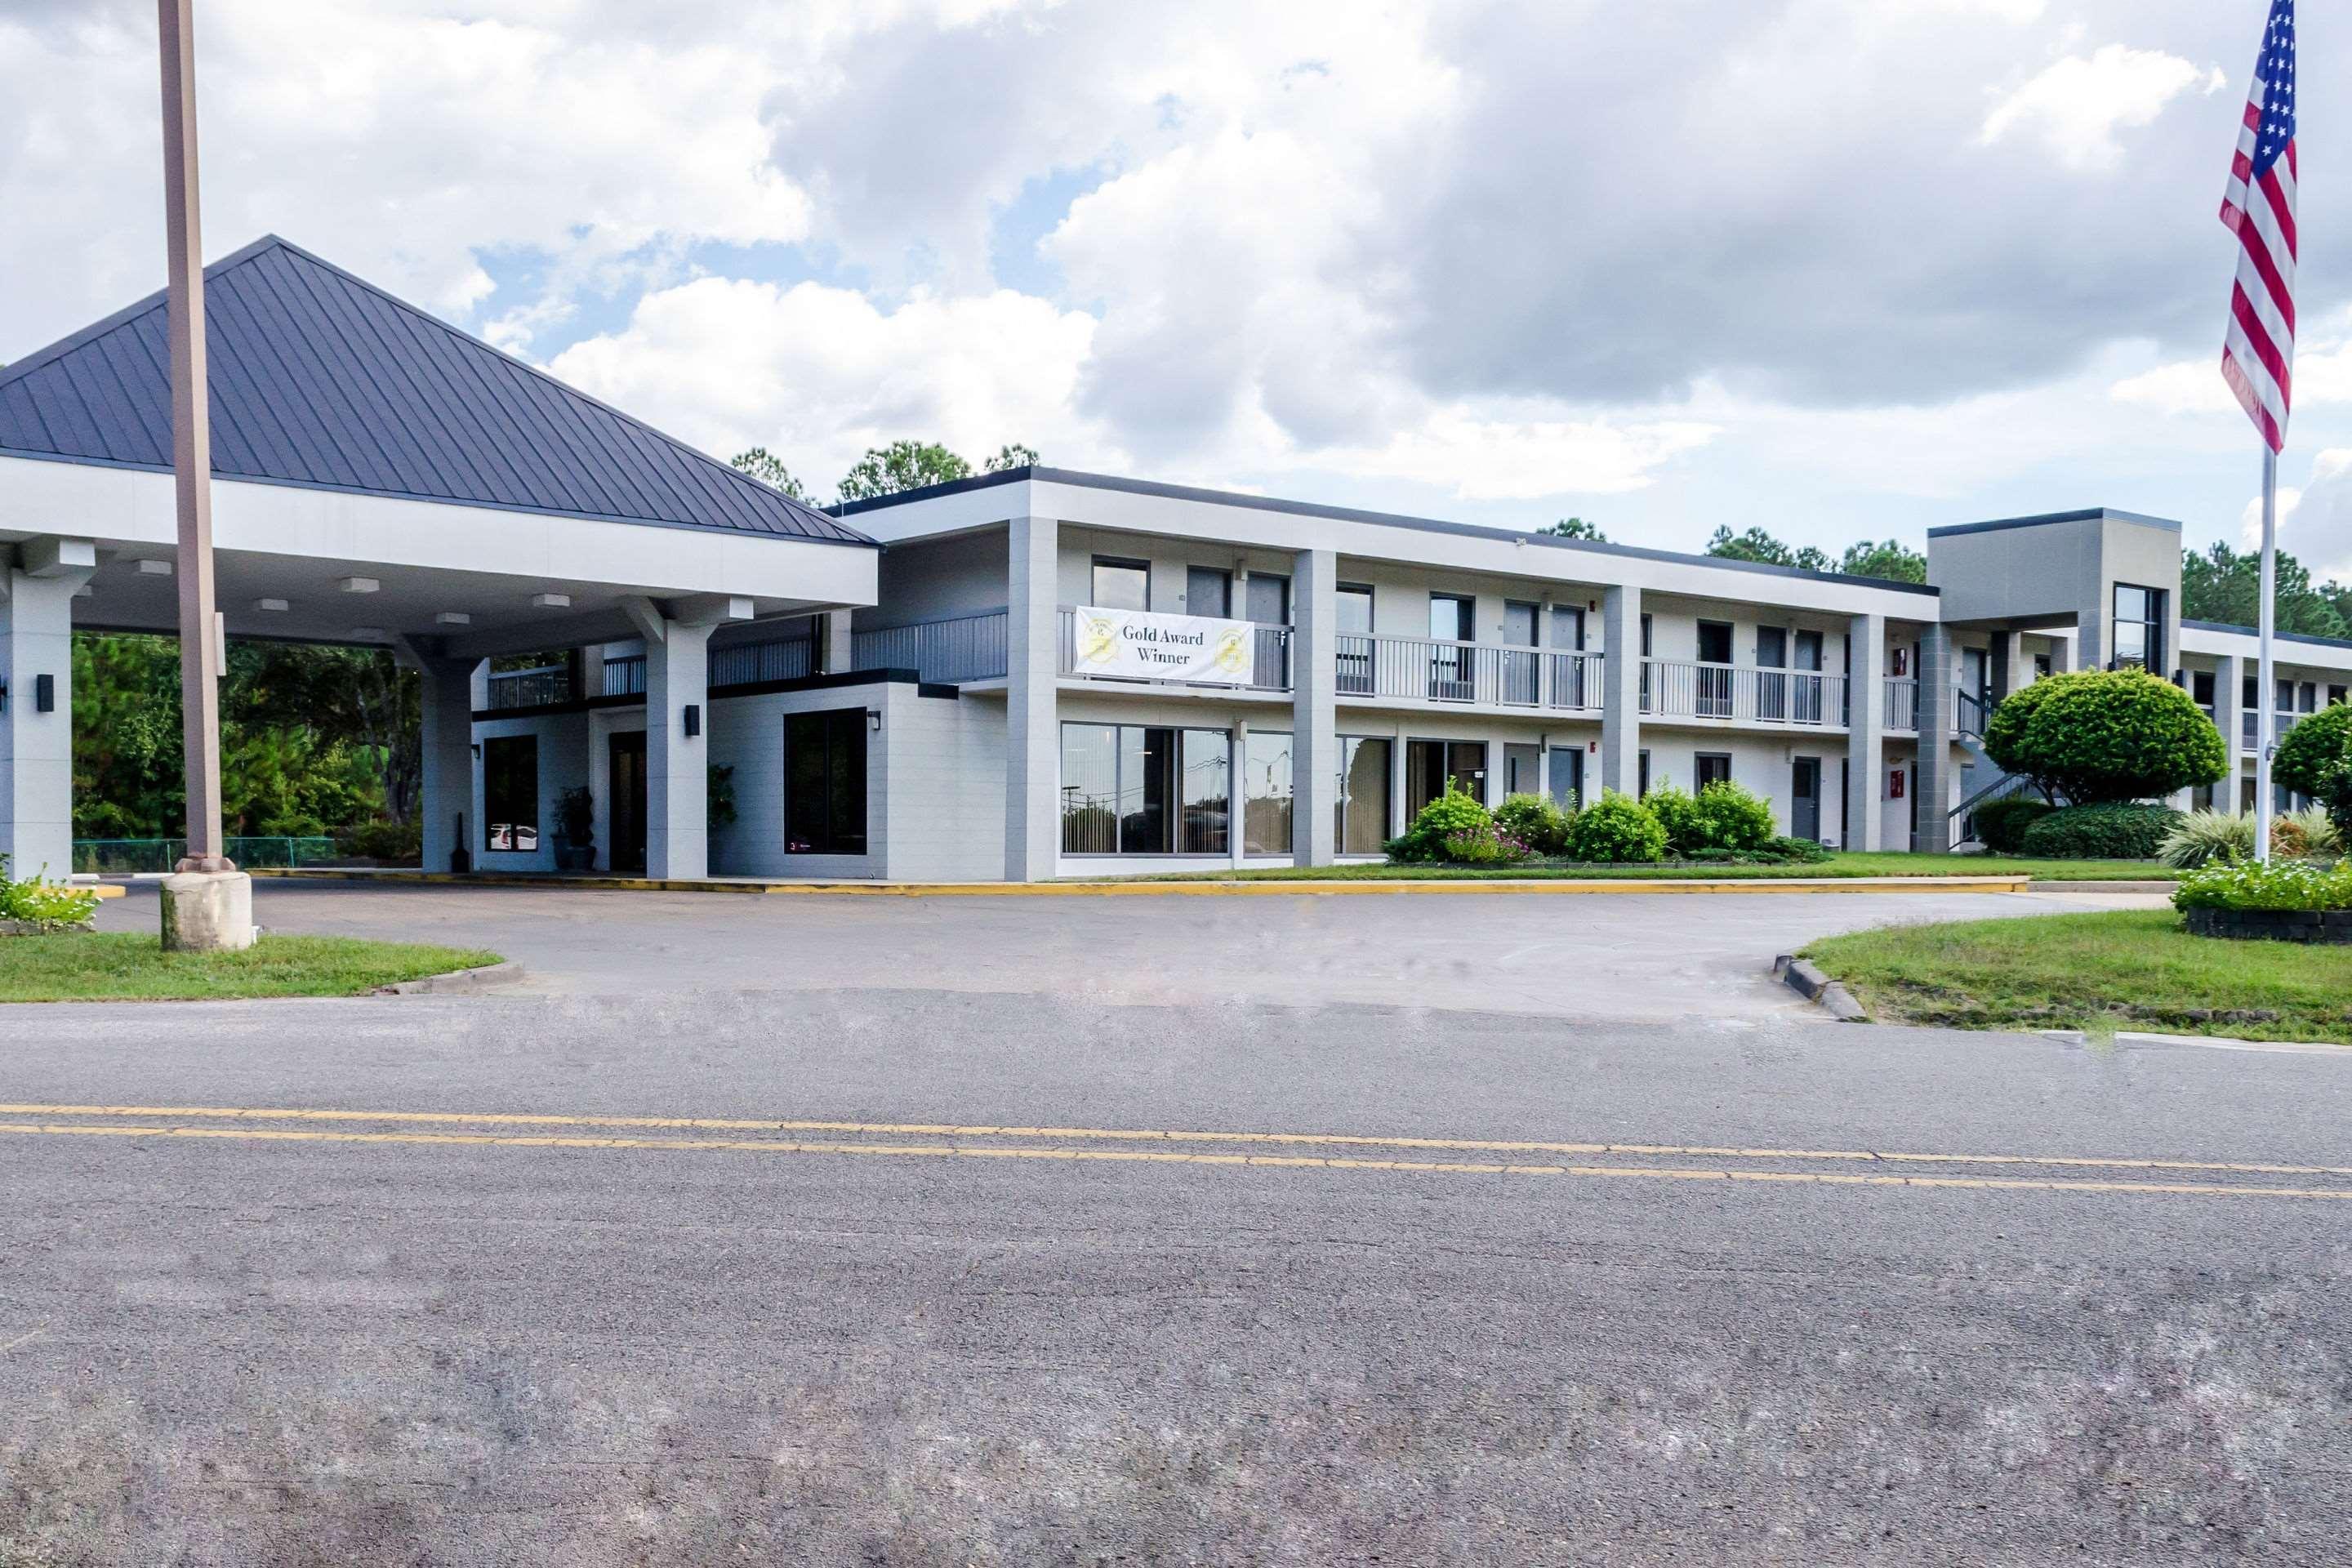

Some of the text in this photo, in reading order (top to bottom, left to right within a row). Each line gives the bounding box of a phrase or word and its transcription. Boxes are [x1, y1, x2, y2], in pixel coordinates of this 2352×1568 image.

[1123, 626, 1157, 642] Gold
[1160, 629, 1203, 645] Award
[1137, 647, 1190, 664] Winner
